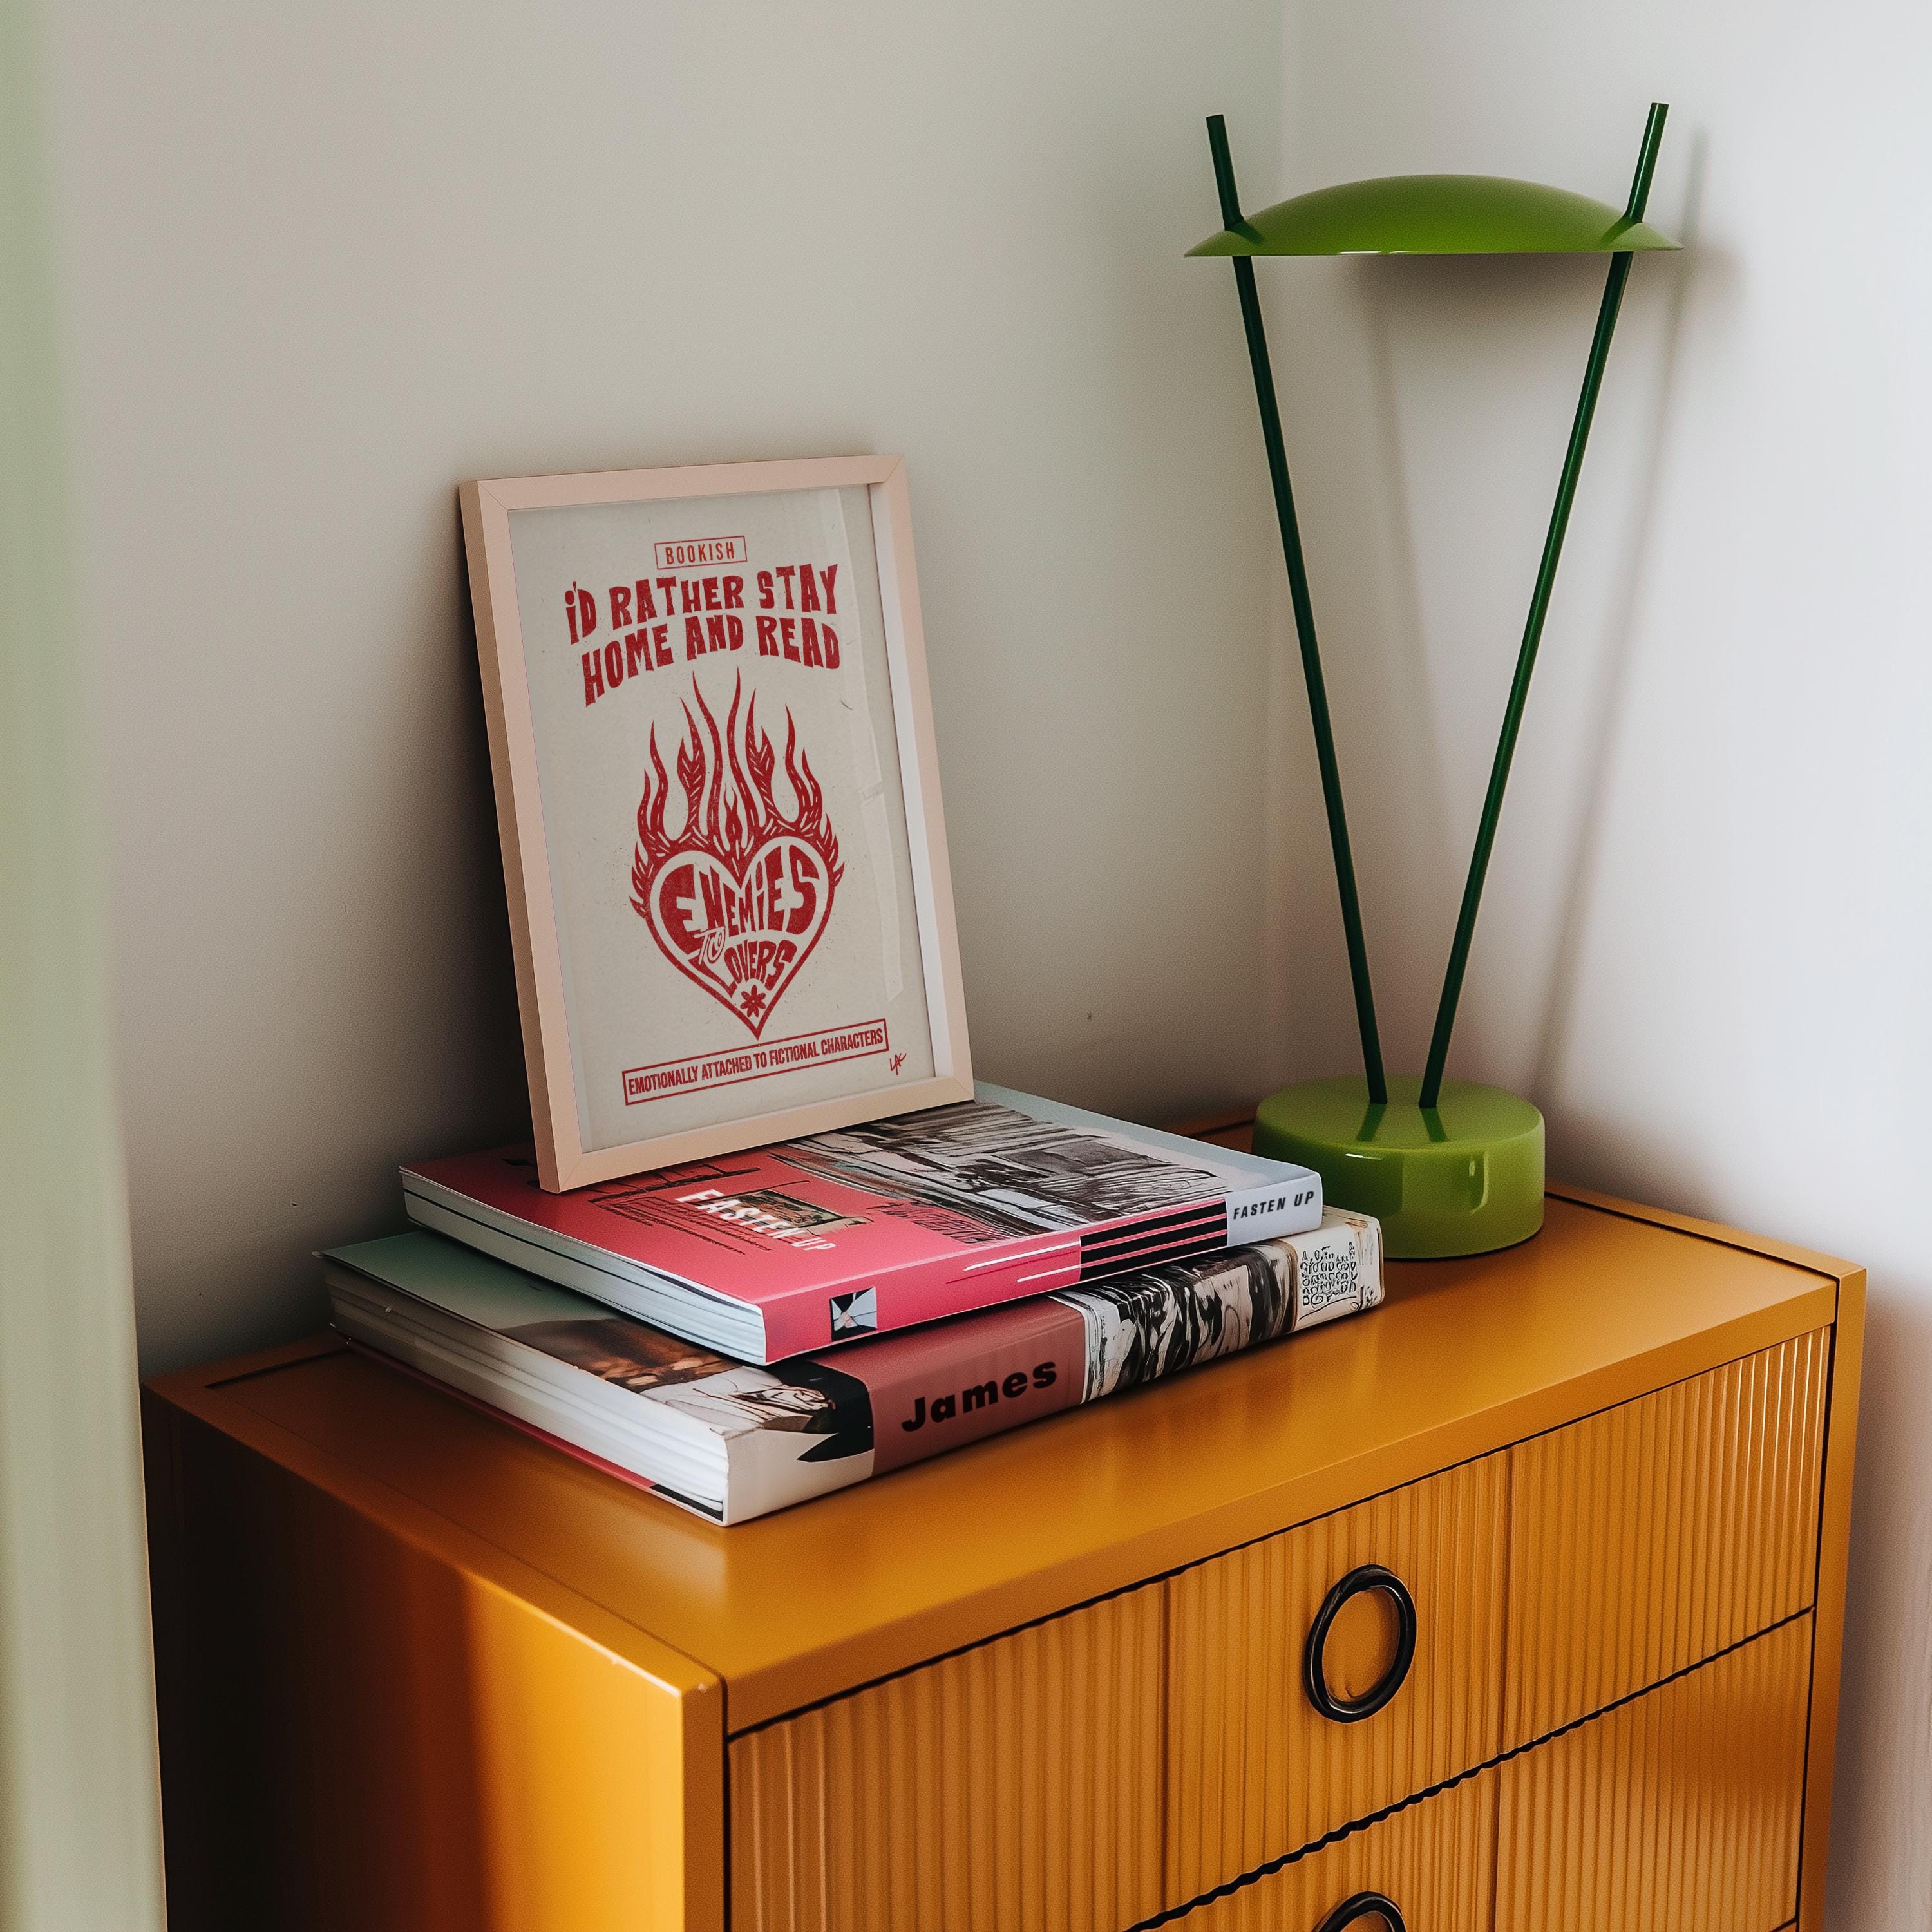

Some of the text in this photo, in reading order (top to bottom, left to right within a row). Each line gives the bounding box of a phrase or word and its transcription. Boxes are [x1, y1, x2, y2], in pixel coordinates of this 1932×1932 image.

[665, 542, 734, 564] BOOKISH
[609, 576, 744, 630] RATHER
[757, 564, 838, 614] STAY
[582, 615, 840, 706] HOME AND READ
[688, 940, 797, 998] LOVERS
[629, 1028, 883, 1095] EMOTIONALLY ATTACHED TO FICTIONAL CHARACTERS
[676, 1189, 836, 1251] FASTEN UP
[1233, 1191, 1314, 1220] FASTEN UP
[901, 1361, 1057, 1432] James
